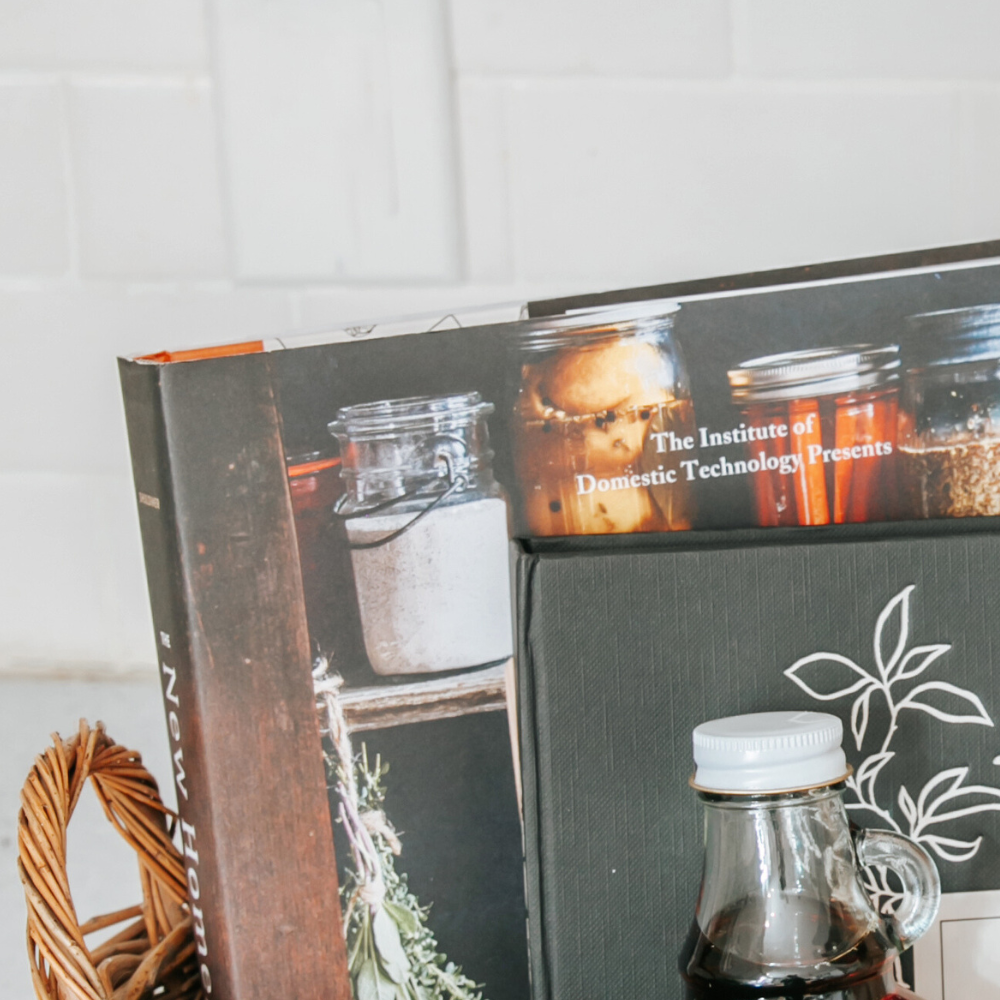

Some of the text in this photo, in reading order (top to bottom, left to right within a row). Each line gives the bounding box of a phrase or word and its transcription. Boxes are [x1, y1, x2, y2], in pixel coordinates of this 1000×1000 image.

[650, 413, 816, 453] The Institute of
[576, 441, 893, 495] Domestic Technology Presents
